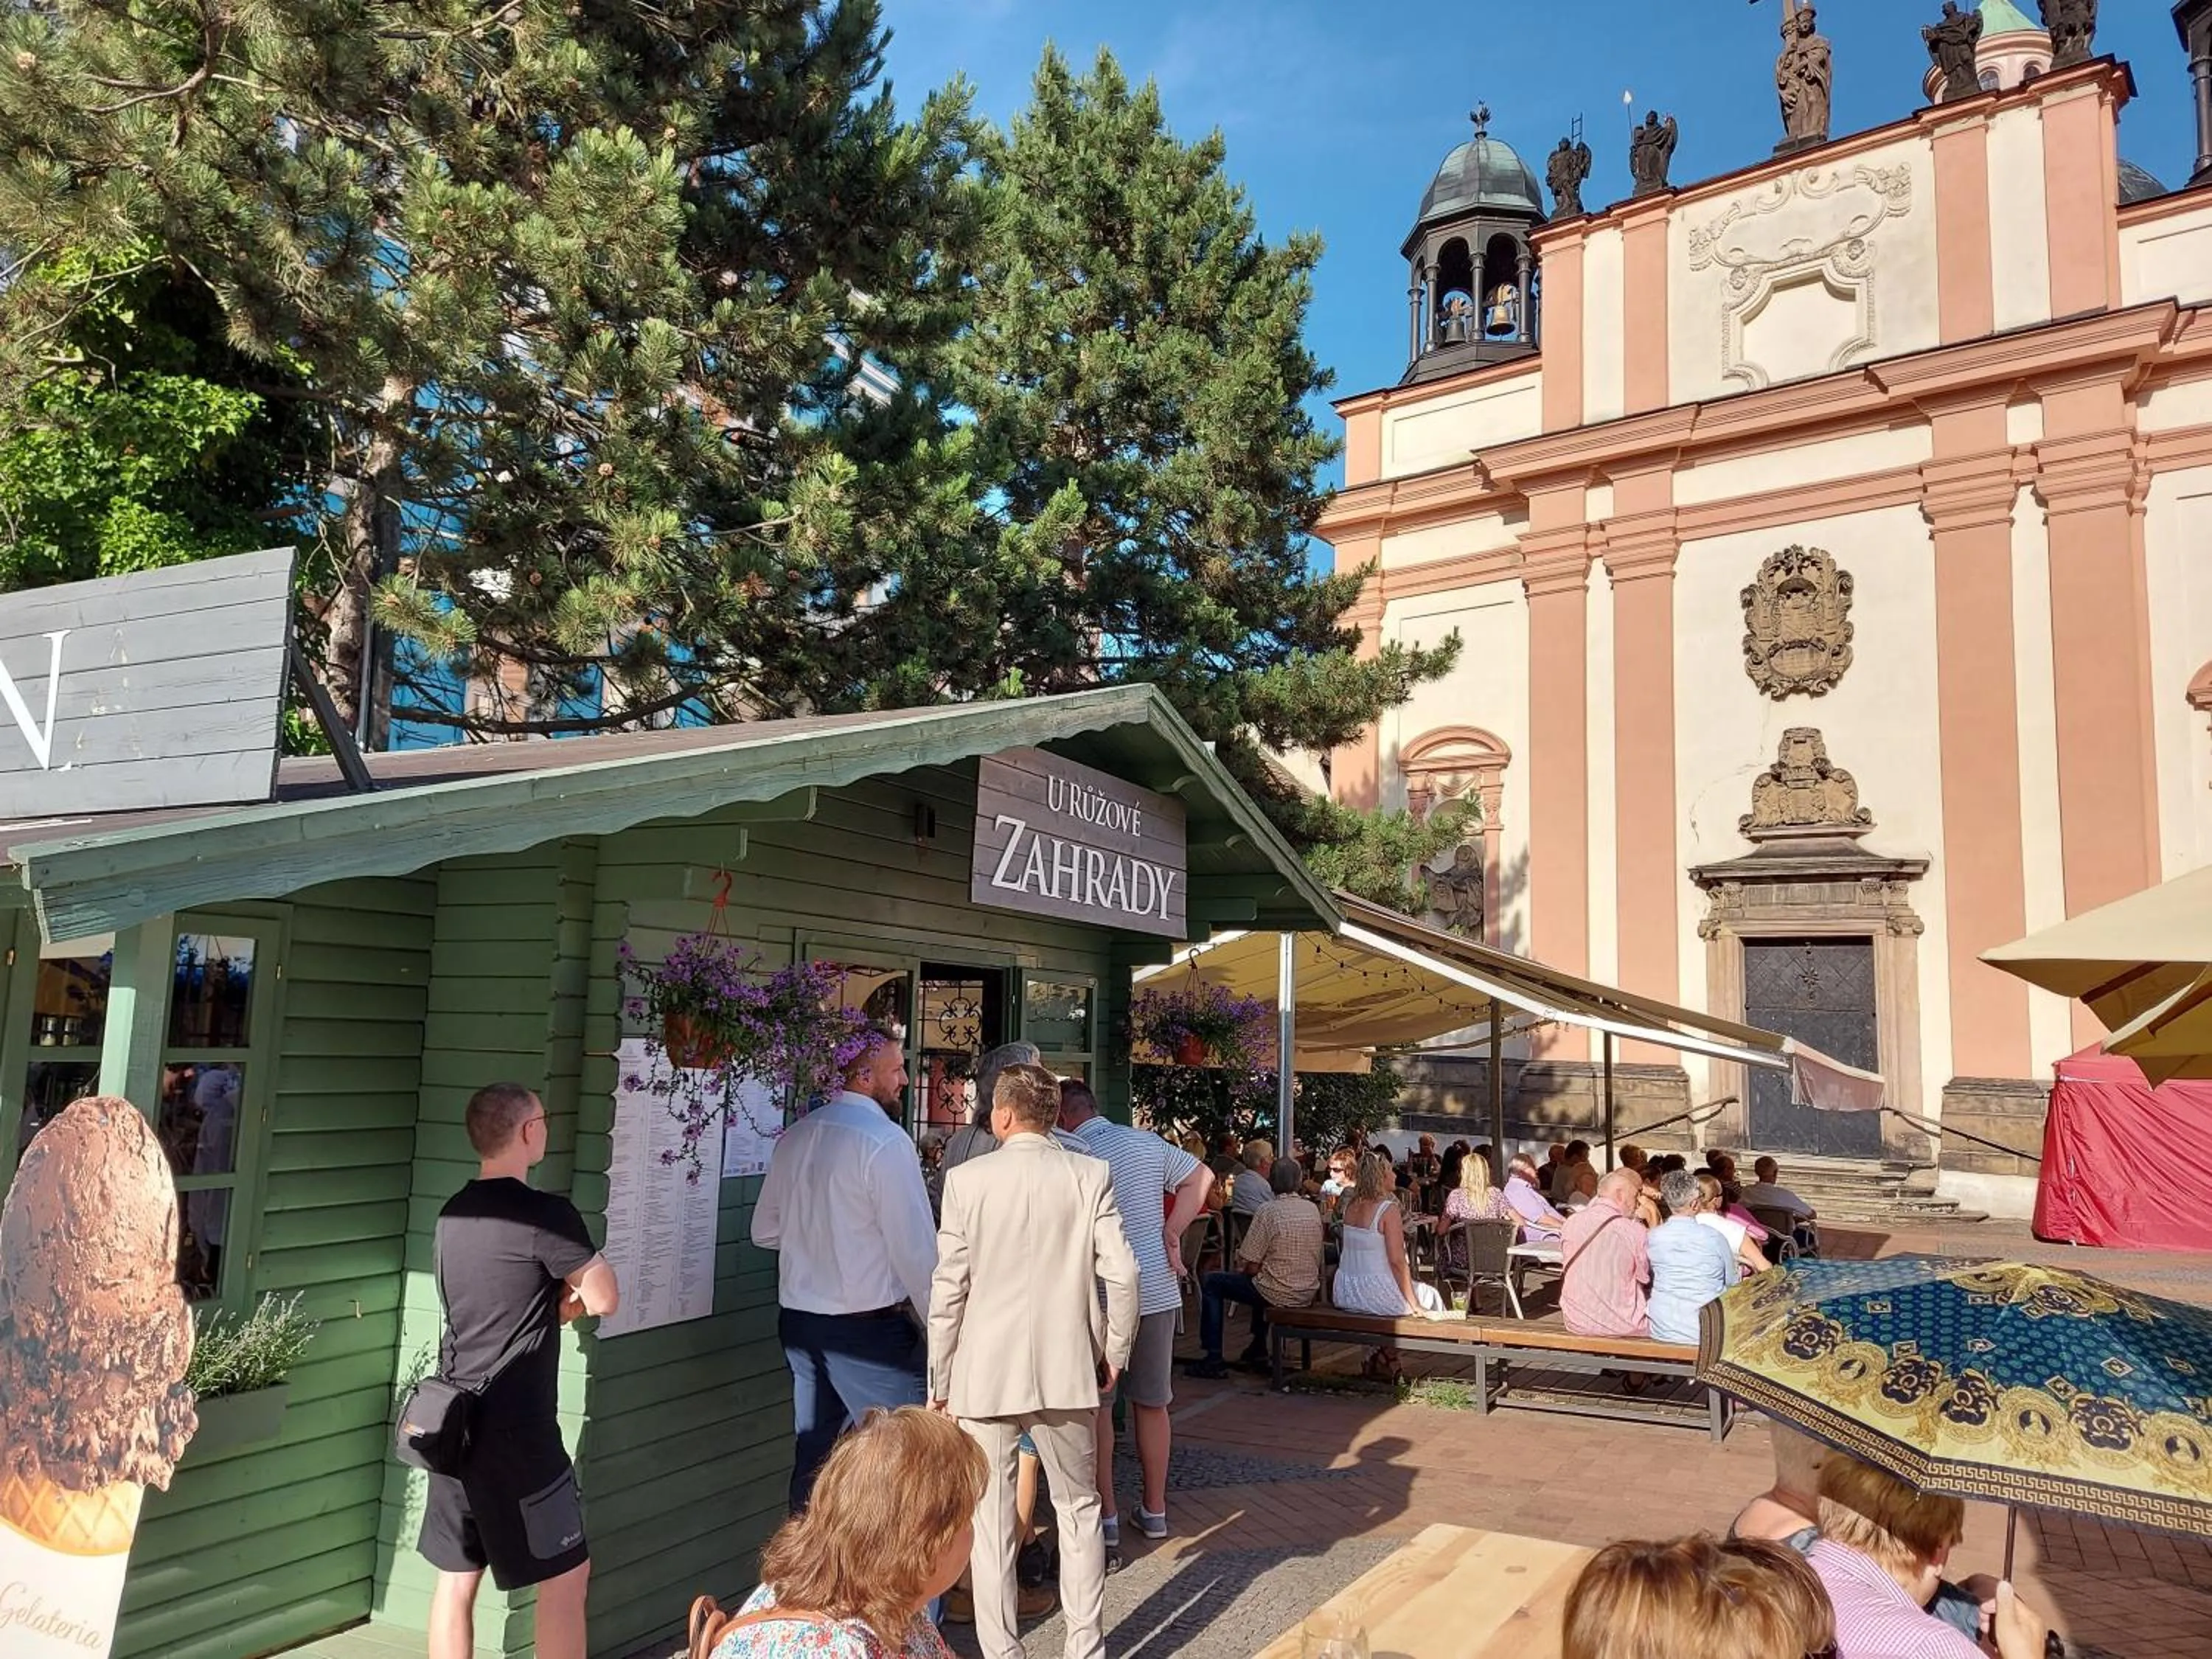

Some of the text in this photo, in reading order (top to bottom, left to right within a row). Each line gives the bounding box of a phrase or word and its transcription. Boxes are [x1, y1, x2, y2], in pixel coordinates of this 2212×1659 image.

[1047, 774, 1141, 837] U RŮŽOVÉ
[991, 814, 1177, 922] ZAHRADY
[0, 1580, 103, 1650] Gelateria
